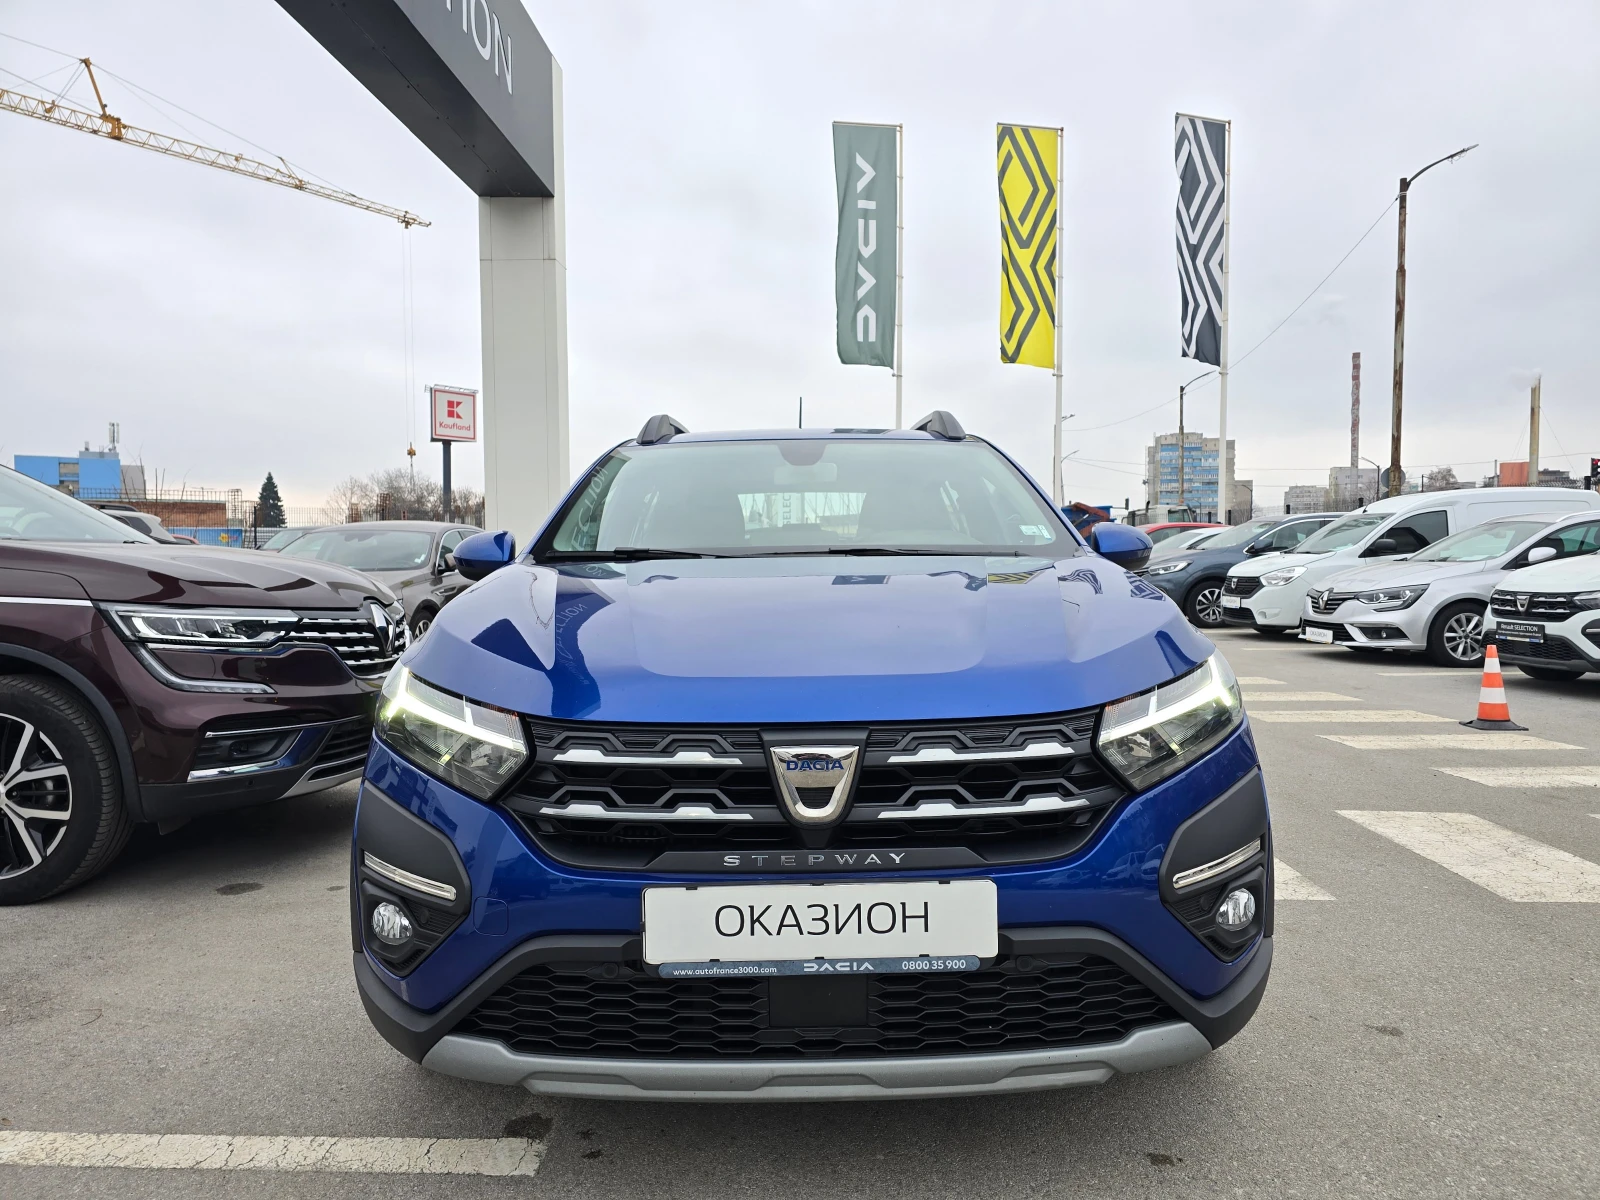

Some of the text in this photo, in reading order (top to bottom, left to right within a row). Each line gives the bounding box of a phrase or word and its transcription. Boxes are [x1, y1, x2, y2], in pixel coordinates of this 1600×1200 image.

[446, 0, 512, 95] ION
[855, 152, 876, 342] DACIA
[439, 421, 470, 431] Kaufland
[785, 759, 844, 772] DACIA
[723, 852, 906, 867] STEPWAY
[714, 901, 929, 938] ОКАЗИОН
[672, 965, 778, 976] www.autofrance3000.com
[803, 961, 875, 972] DACIA
[901, 959, 967, 970] 0800 35 900
